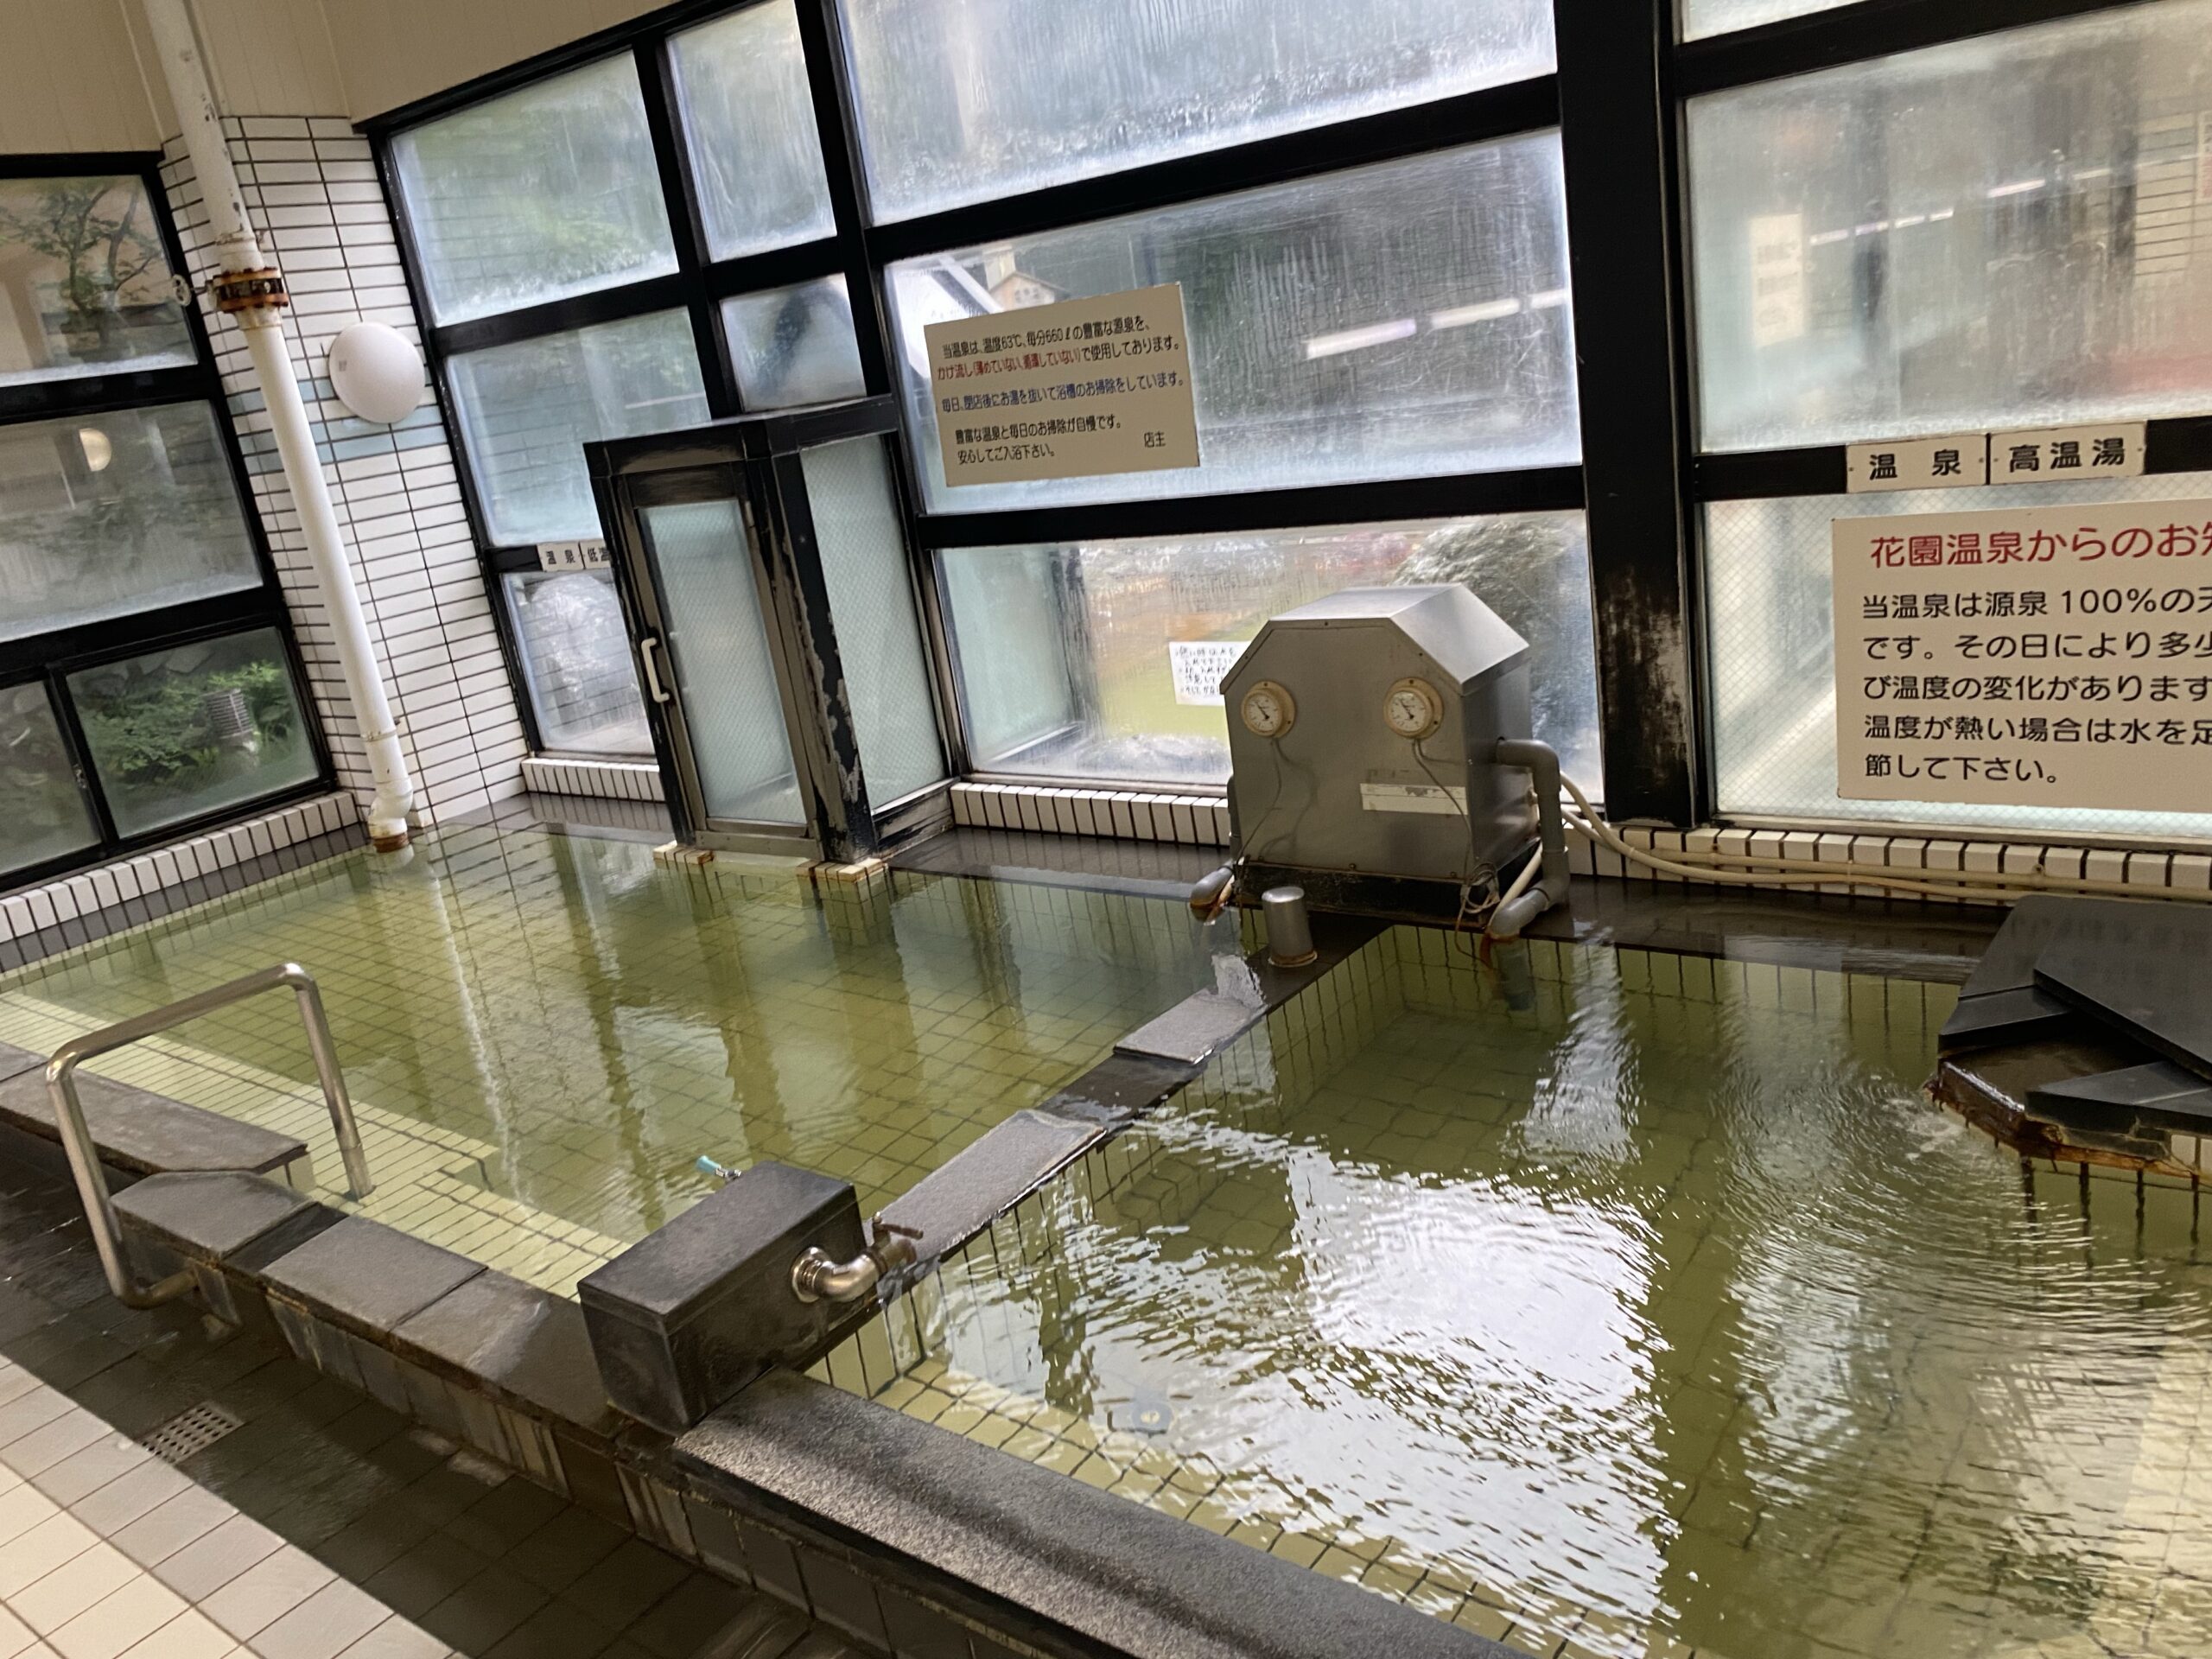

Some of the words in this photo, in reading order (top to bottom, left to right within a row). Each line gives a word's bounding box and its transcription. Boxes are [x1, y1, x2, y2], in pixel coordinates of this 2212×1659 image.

[957, 442, 1055, 466] 安心してご入浴下さい。
[1143, 431, 1166, 448] 店主
[2008, 436, 2126, 473] 高温湯
[1868, 448, 1962, 480] 温泉
[1870, 522, 2212, 569] 花園温泉からのお
[1863, 674, 2212, 702] び温度の変化があります
[1865, 753, 2058, 785] 節して下さい。
